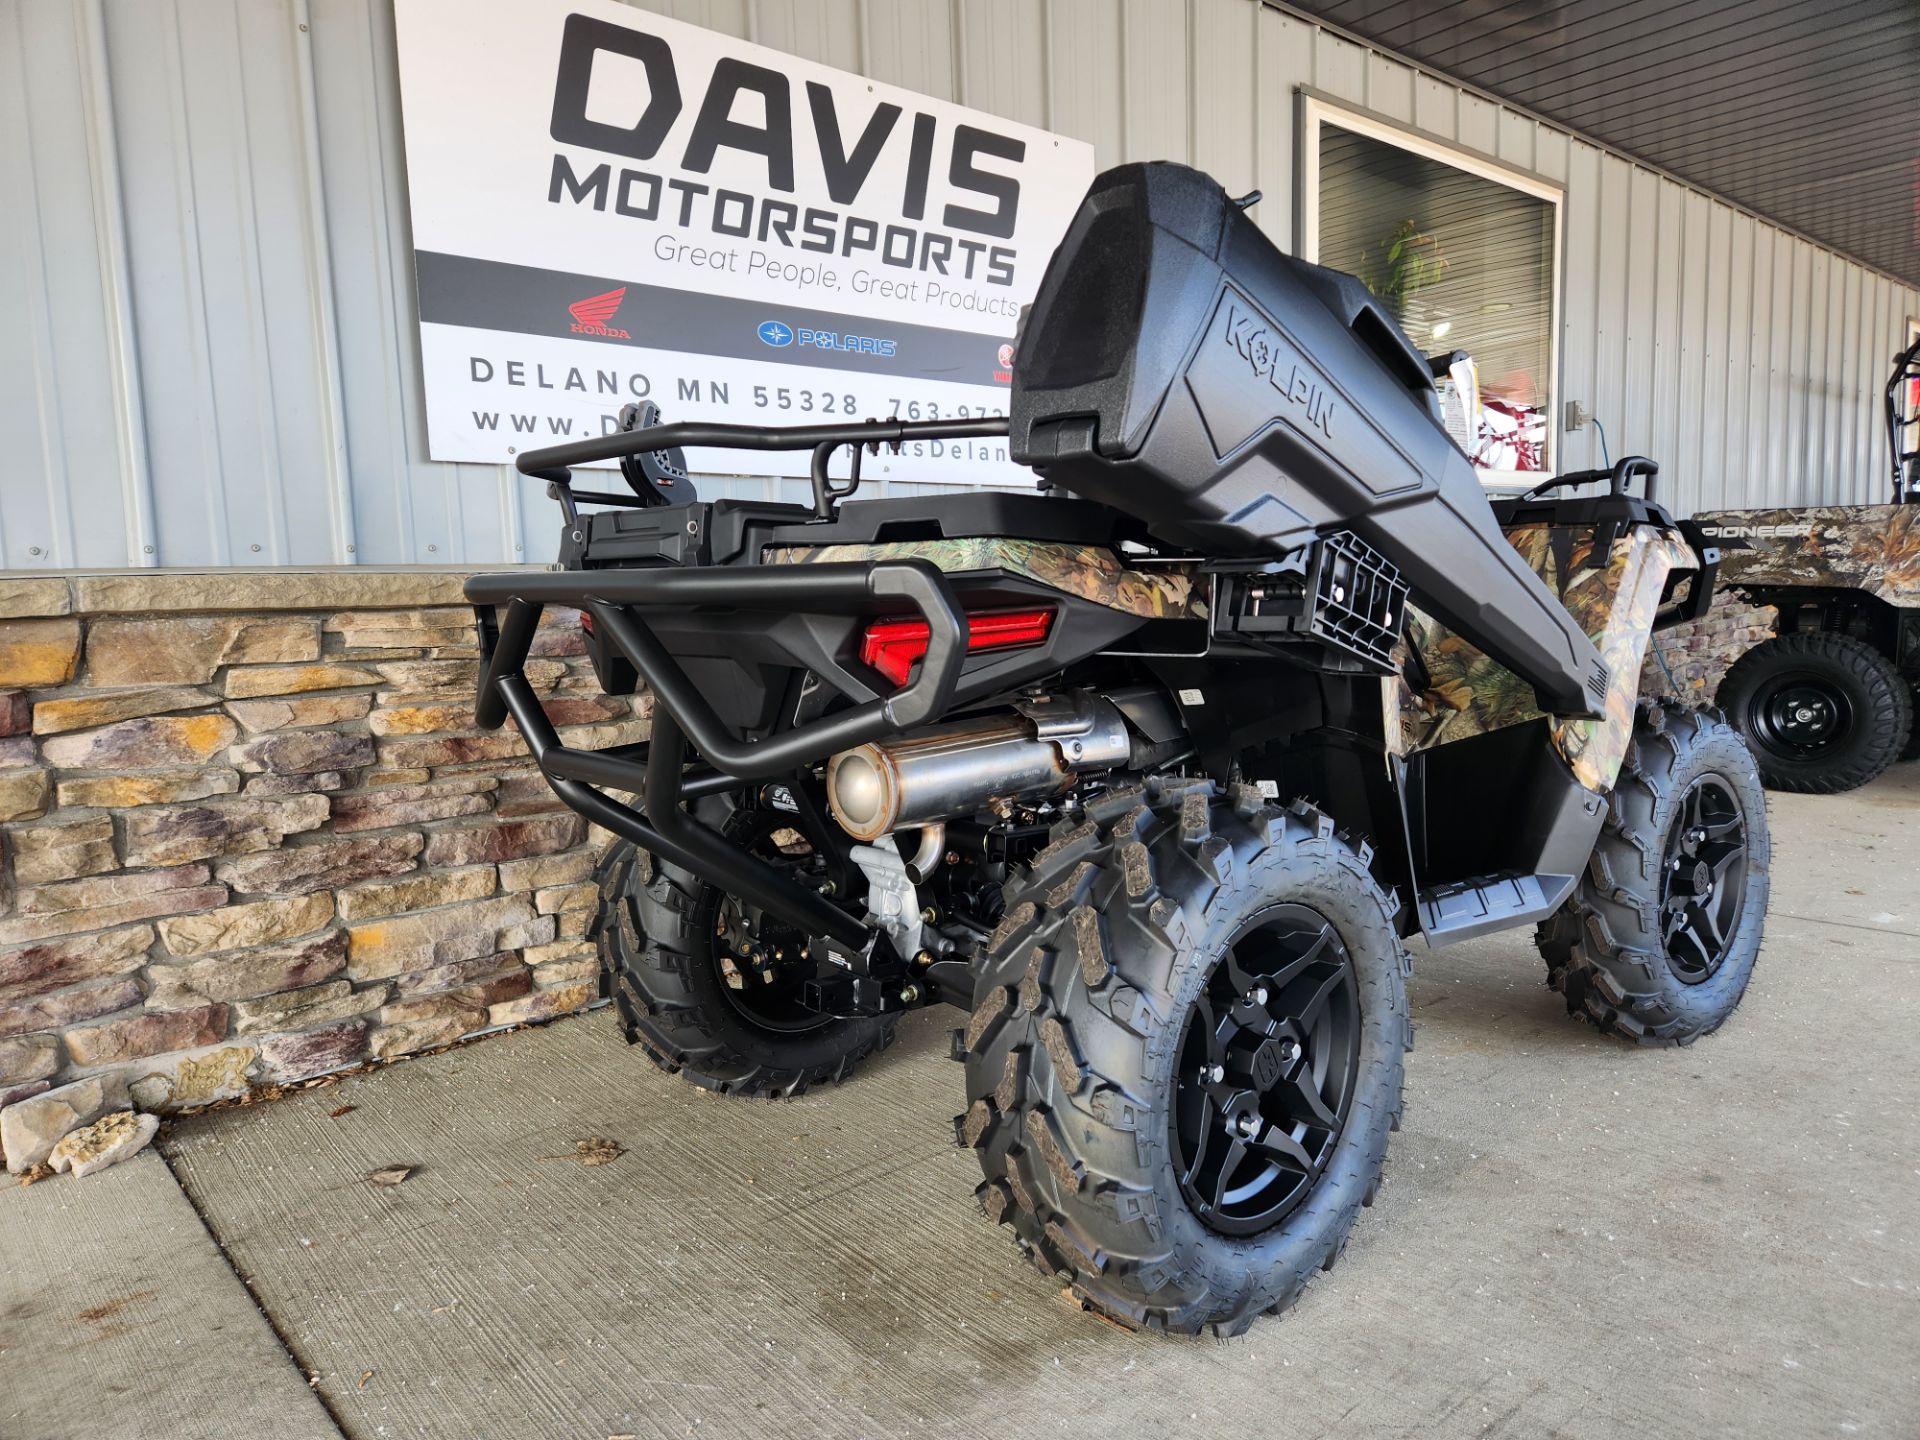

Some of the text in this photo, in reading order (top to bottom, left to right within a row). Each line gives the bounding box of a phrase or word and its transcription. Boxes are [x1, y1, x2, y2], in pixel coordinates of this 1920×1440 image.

[550, 13, 1026, 239] DAVIS
[548, 154, 1016, 286] MOTORSPORTS
[654, 234, 1018, 318] Great People, Great Products
[570, 323, 632, 339] HONDA
[798, 328, 896, 357] POLARIS
[470, 356, 651, 398] DELANO
[677, 378, 730, 405] MN
[753, 385, 857, 415] 55328
[1224, 304, 1338, 440] KOLPIN
[1701, 524, 1813, 538] PIONEER
